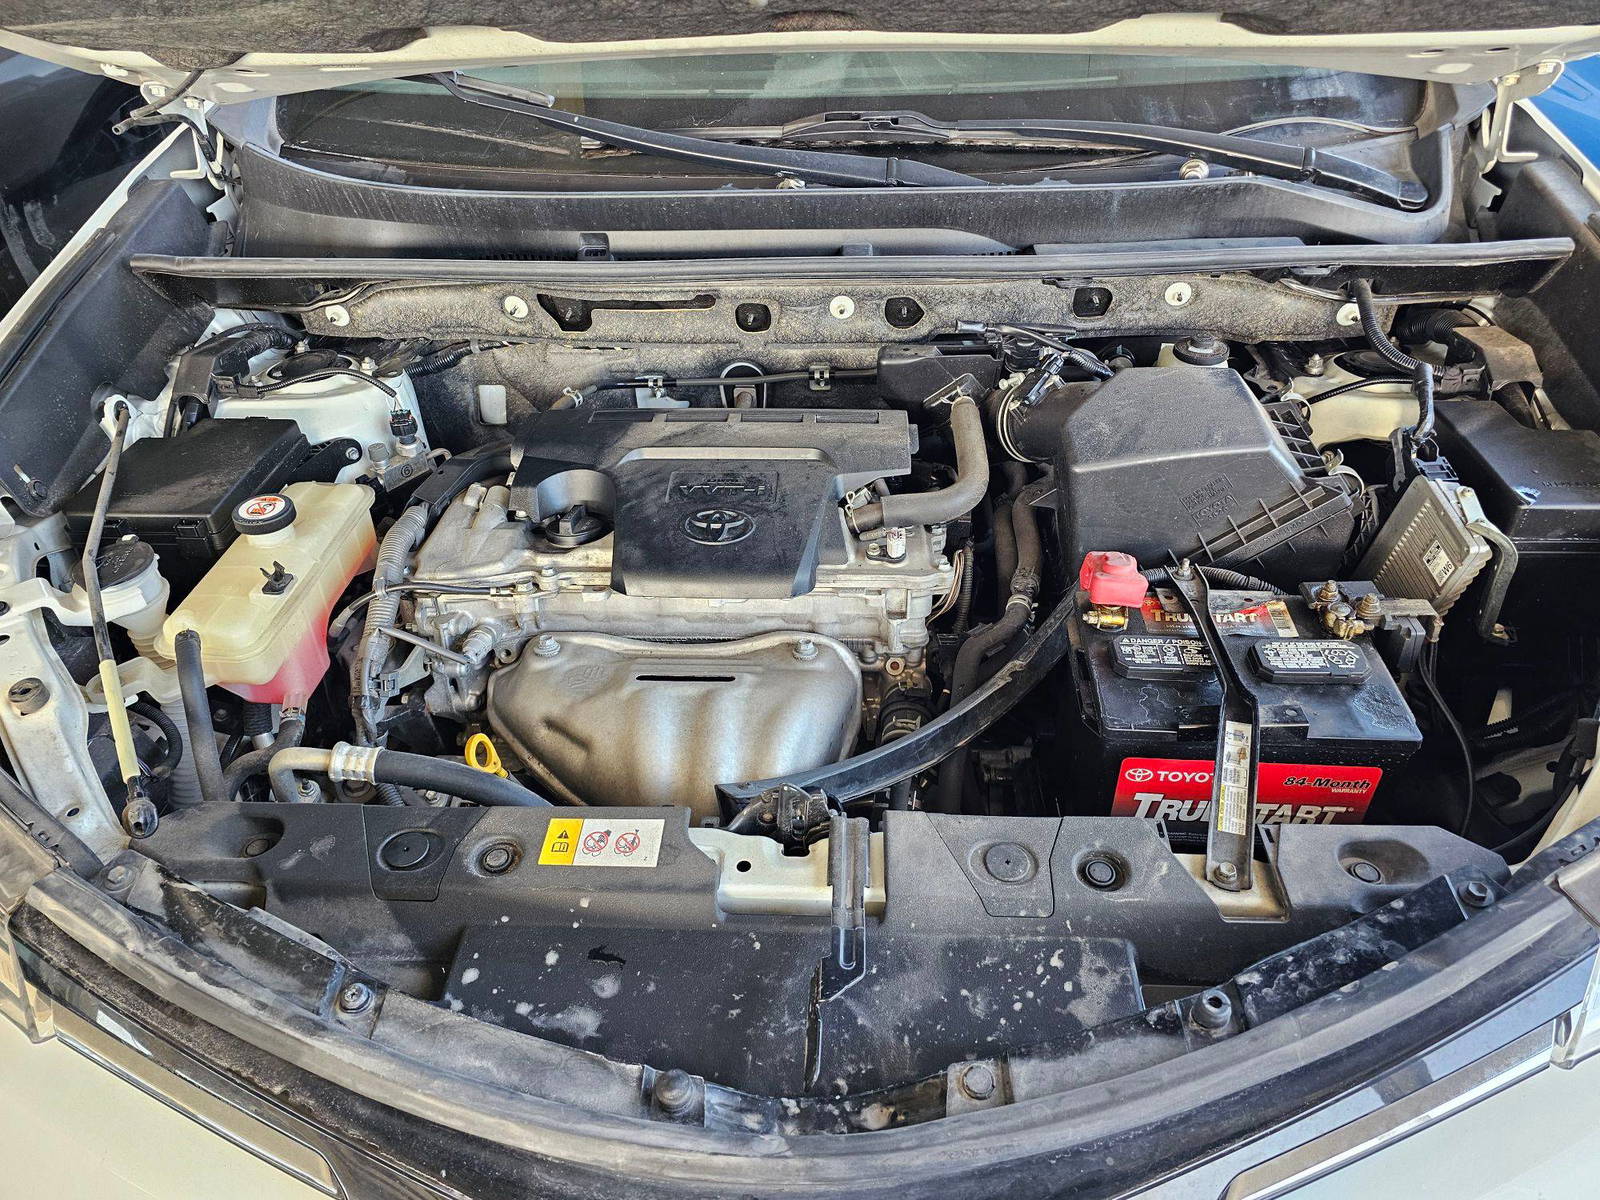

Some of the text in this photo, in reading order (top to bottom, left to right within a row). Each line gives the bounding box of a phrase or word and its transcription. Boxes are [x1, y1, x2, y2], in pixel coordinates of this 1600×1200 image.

[1157, 770, 1215, 783] TOYO
[1282, 776, 1372, 790] 84-Month
[1330, 787, 1368, 795] WARRANTY
